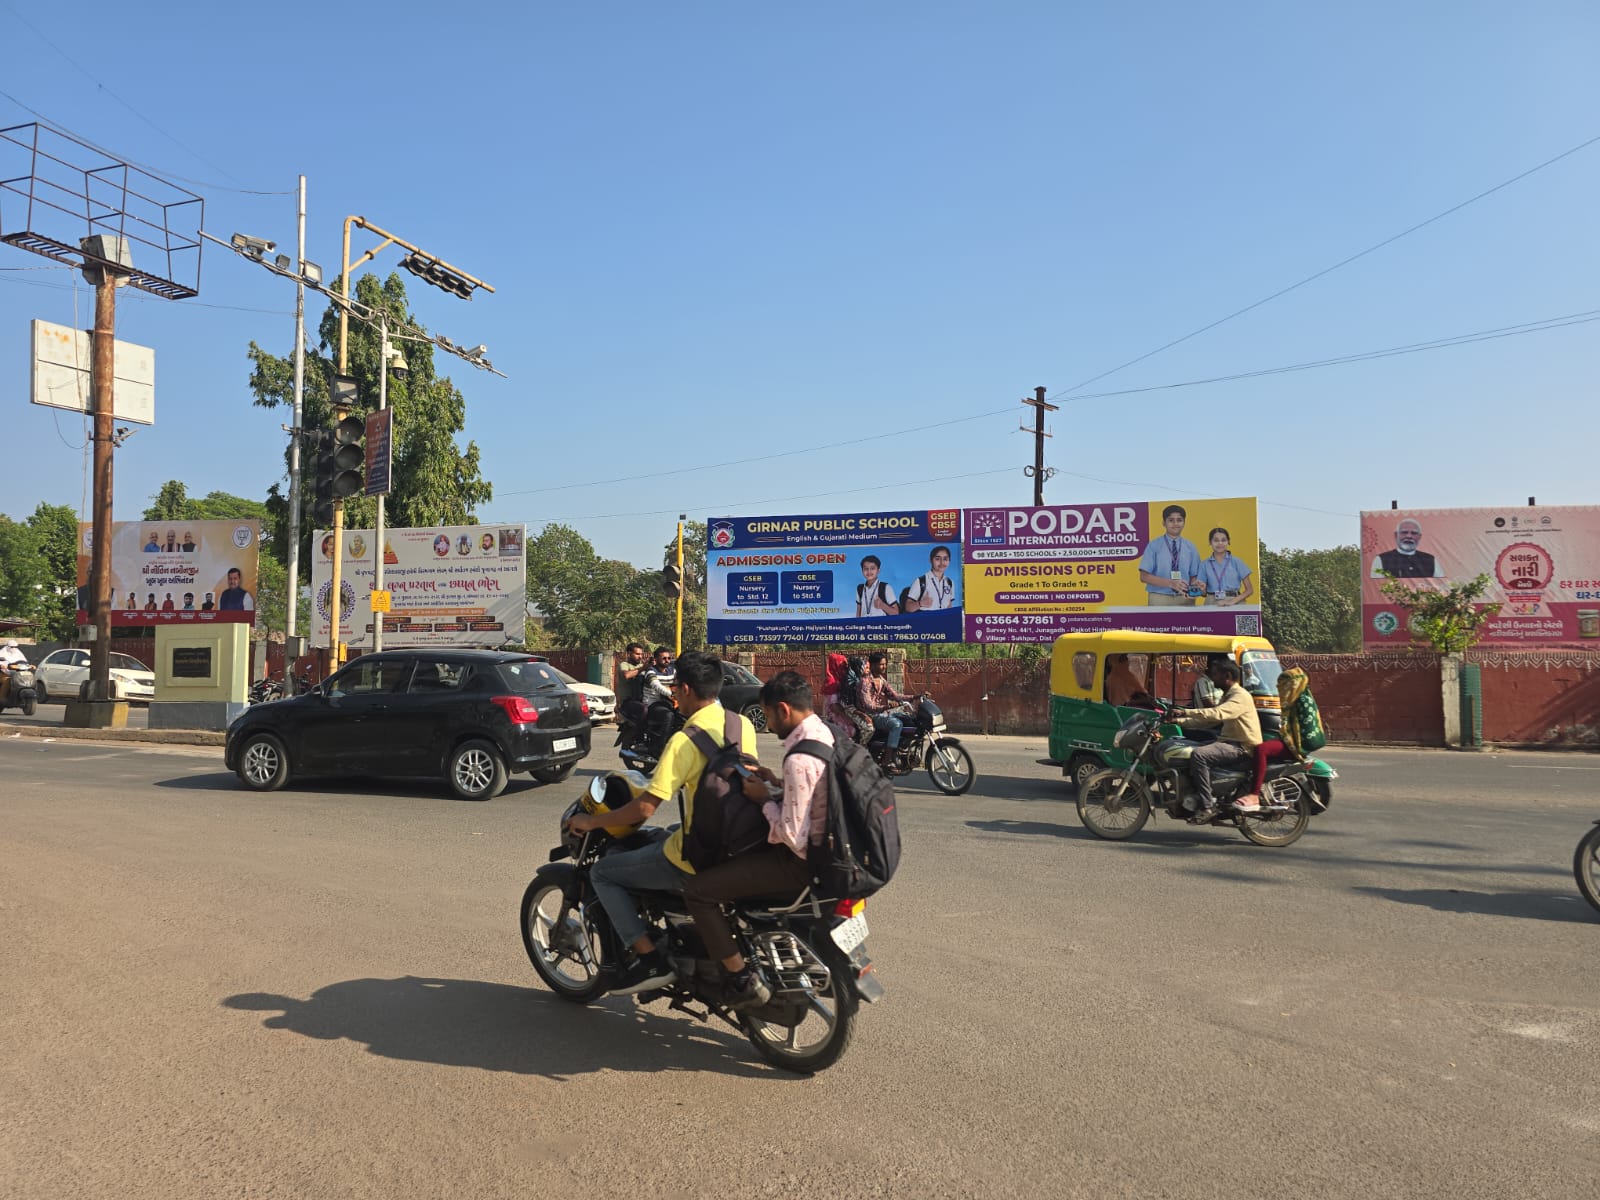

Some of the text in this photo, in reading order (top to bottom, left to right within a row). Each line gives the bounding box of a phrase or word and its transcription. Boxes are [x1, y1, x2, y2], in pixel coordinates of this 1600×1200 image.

[930, 512, 957, 520] GSEB
[747, 516, 920, 533] GIRNAR PUBLIC SCHOOL
[930, 521, 957, 529] CBSE
[1008, 507, 1137, 536] PODAR
[819, 533, 848, 541] Gujarati
[1008, 532, 1140, 546] INTERNATIONAL SCHOOL
[1062, 549, 1097, 557] 2,50,000+
[1098, 548, 1133, 556] STUDENTS
[716, 552, 847, 567] ADMISSIONS OPEN
[1509, 554, 1539, 562] સશક્ત
[984, 564, 1116, 577] ADMISSIONS OPEN
[1511, 562, 1539, 577] નારી
[477, 575, 501, 591] ભોગ
[1052, 580, 1077, 588] Grade
[739, 585, 766, 594] Nursery
[793, 584, 820, 593] Nursery
[984, 615, 1054, 625] 63664 37861
[1488, 620, 1512, 629] સ્વદેશી
[1035, 626, 1066, 634] Junagadh
[1070, 626, 1092, 634] Rajkot
[1192, 625, 1214, 633] Pump,
[859, 633, 866, 641] &
[867, 633, 889, 641] CBSE
